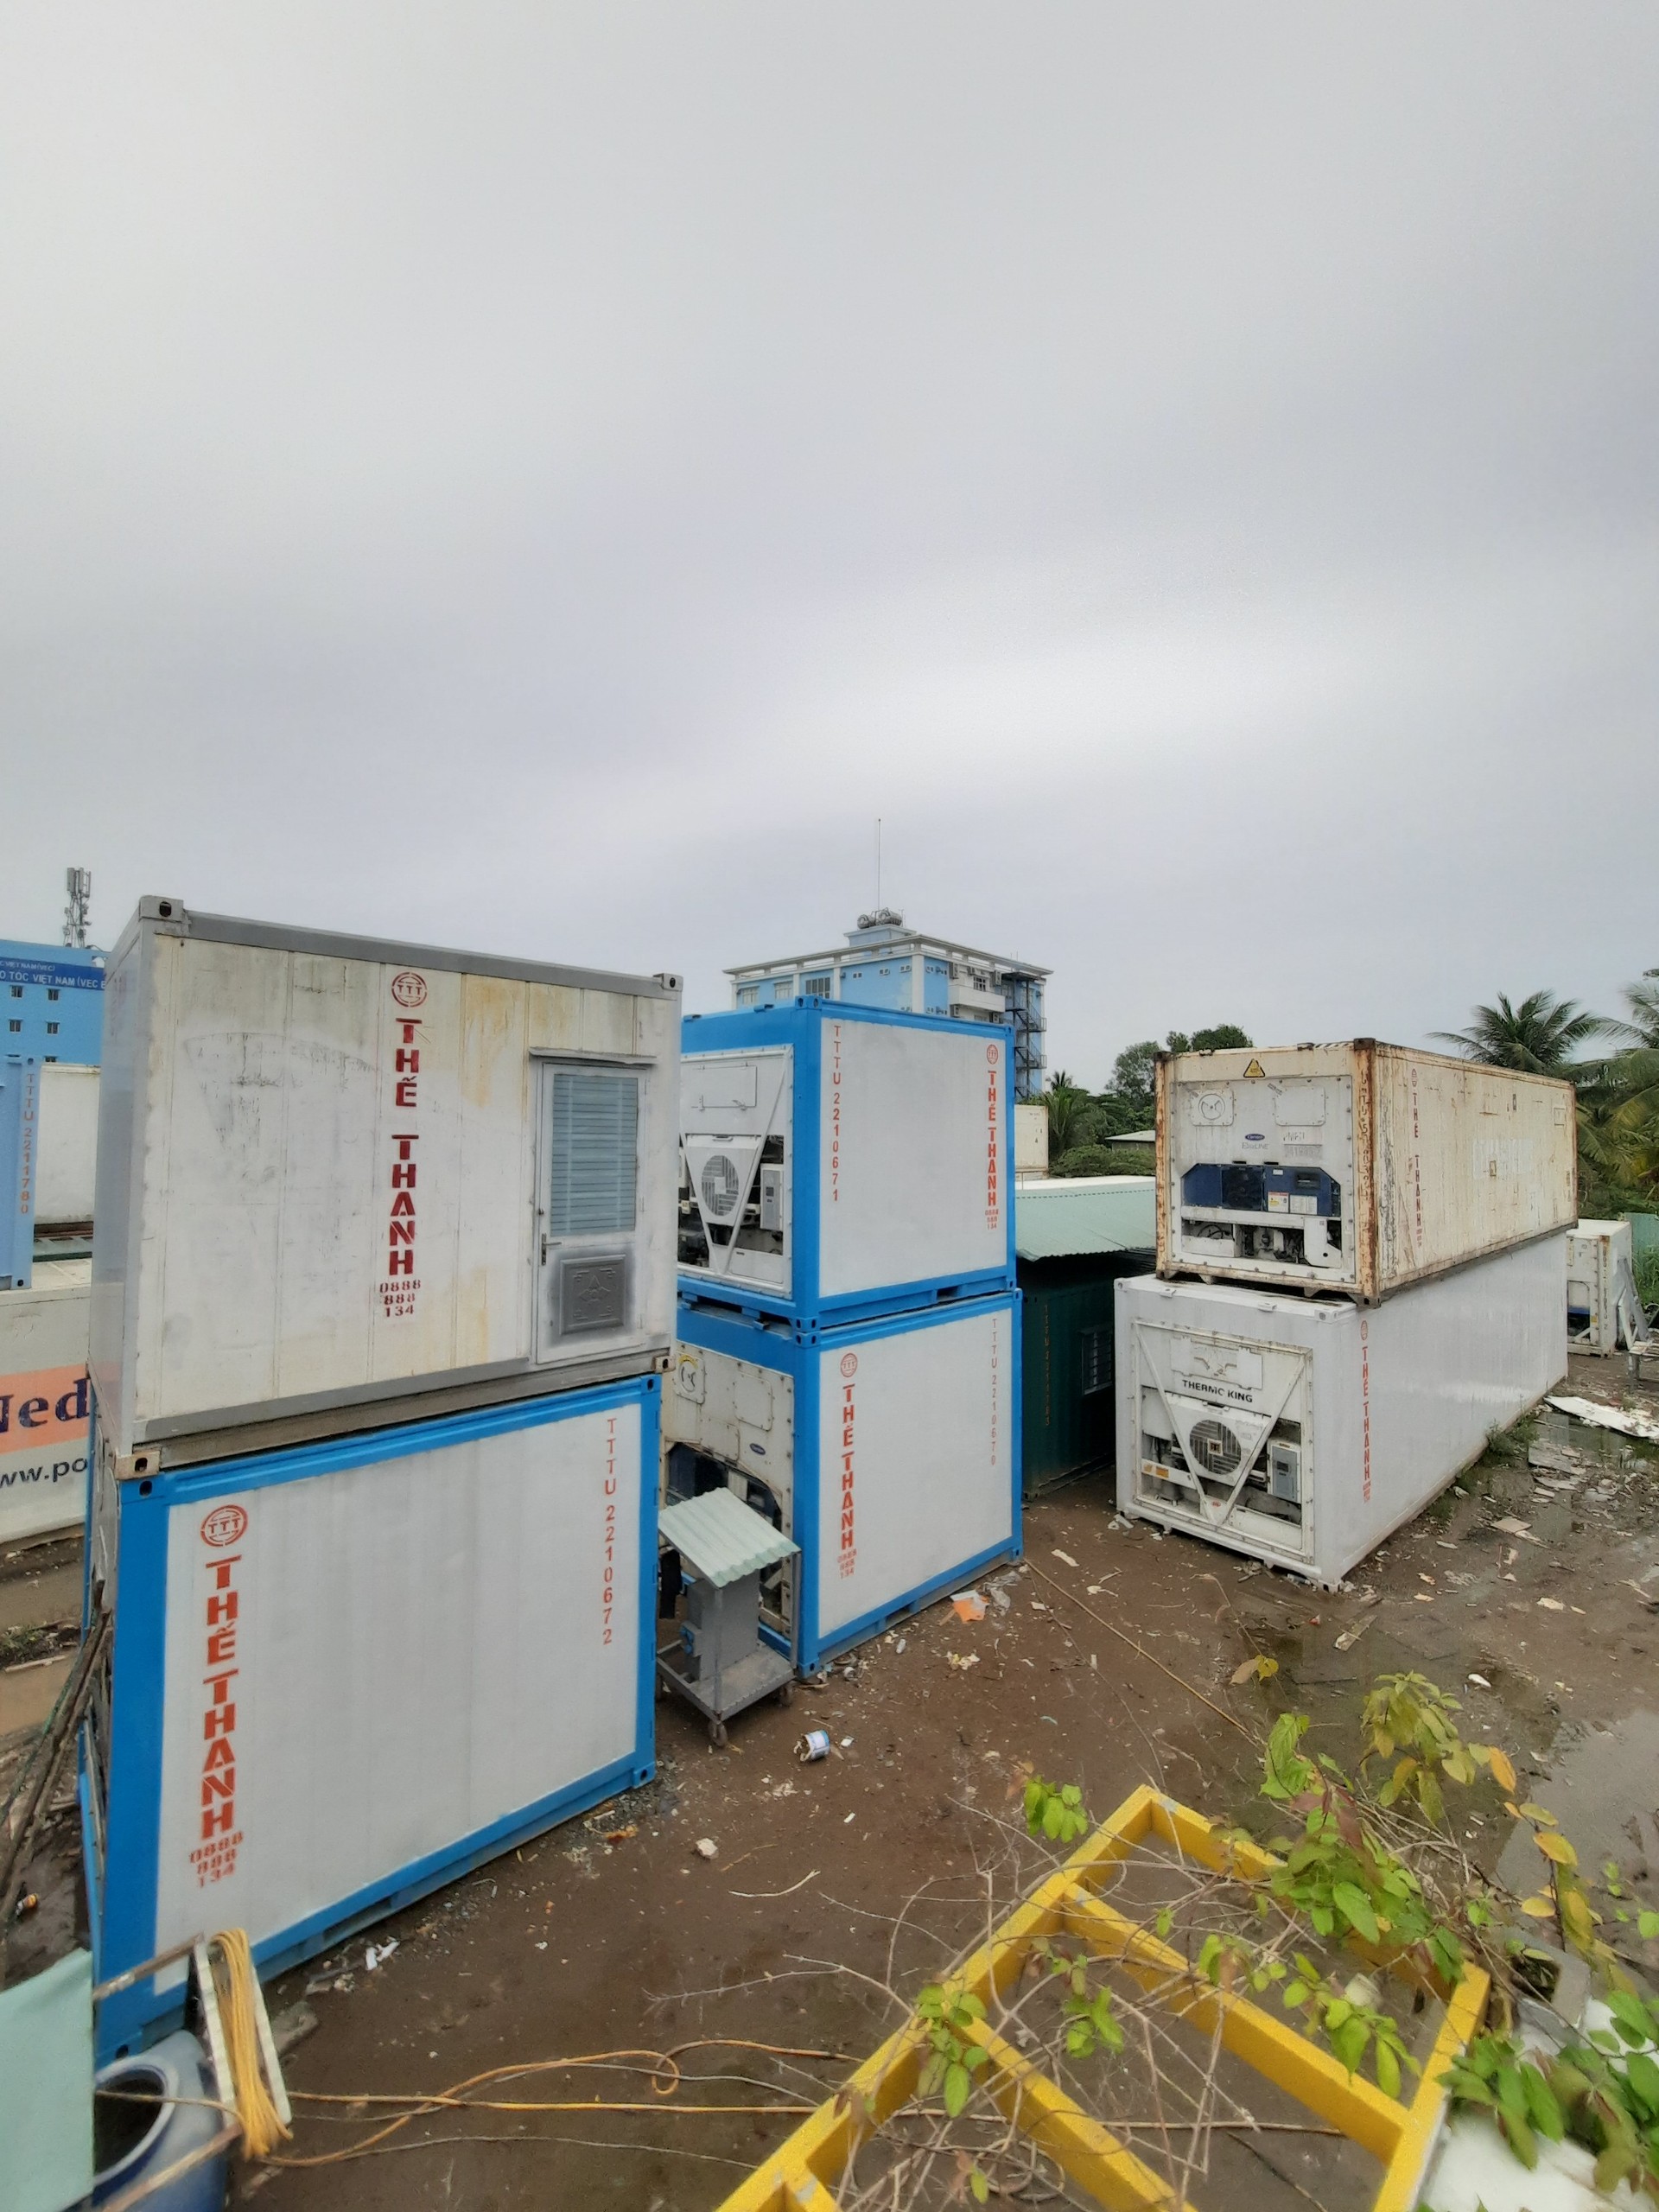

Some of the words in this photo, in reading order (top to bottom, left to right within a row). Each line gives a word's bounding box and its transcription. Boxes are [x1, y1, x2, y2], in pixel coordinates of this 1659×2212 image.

[54, 976, 75, 986] NAM
[397, 984, 422, 995] TTT
[23, 1073, 35, 1122] TTTU
[988, 1127, 997, 1206] THANH
[390, 1135, 419, 1275] THANH
[379, 1279, 422, 1294] 0888
[383, 1293, 416, 1306] 888
[385, 1305, 415, 1318] 134
[1228, 1389, 1253, 1403] KING
[605, 1418, 617, 1496] TTTU
[842, 1452, 855, 1550] THANH
[208, 1517, 241, 1535] TTT
[603, 1505, 616, 1645] 2210672
[201, 1668, 239, 1840] THANH
